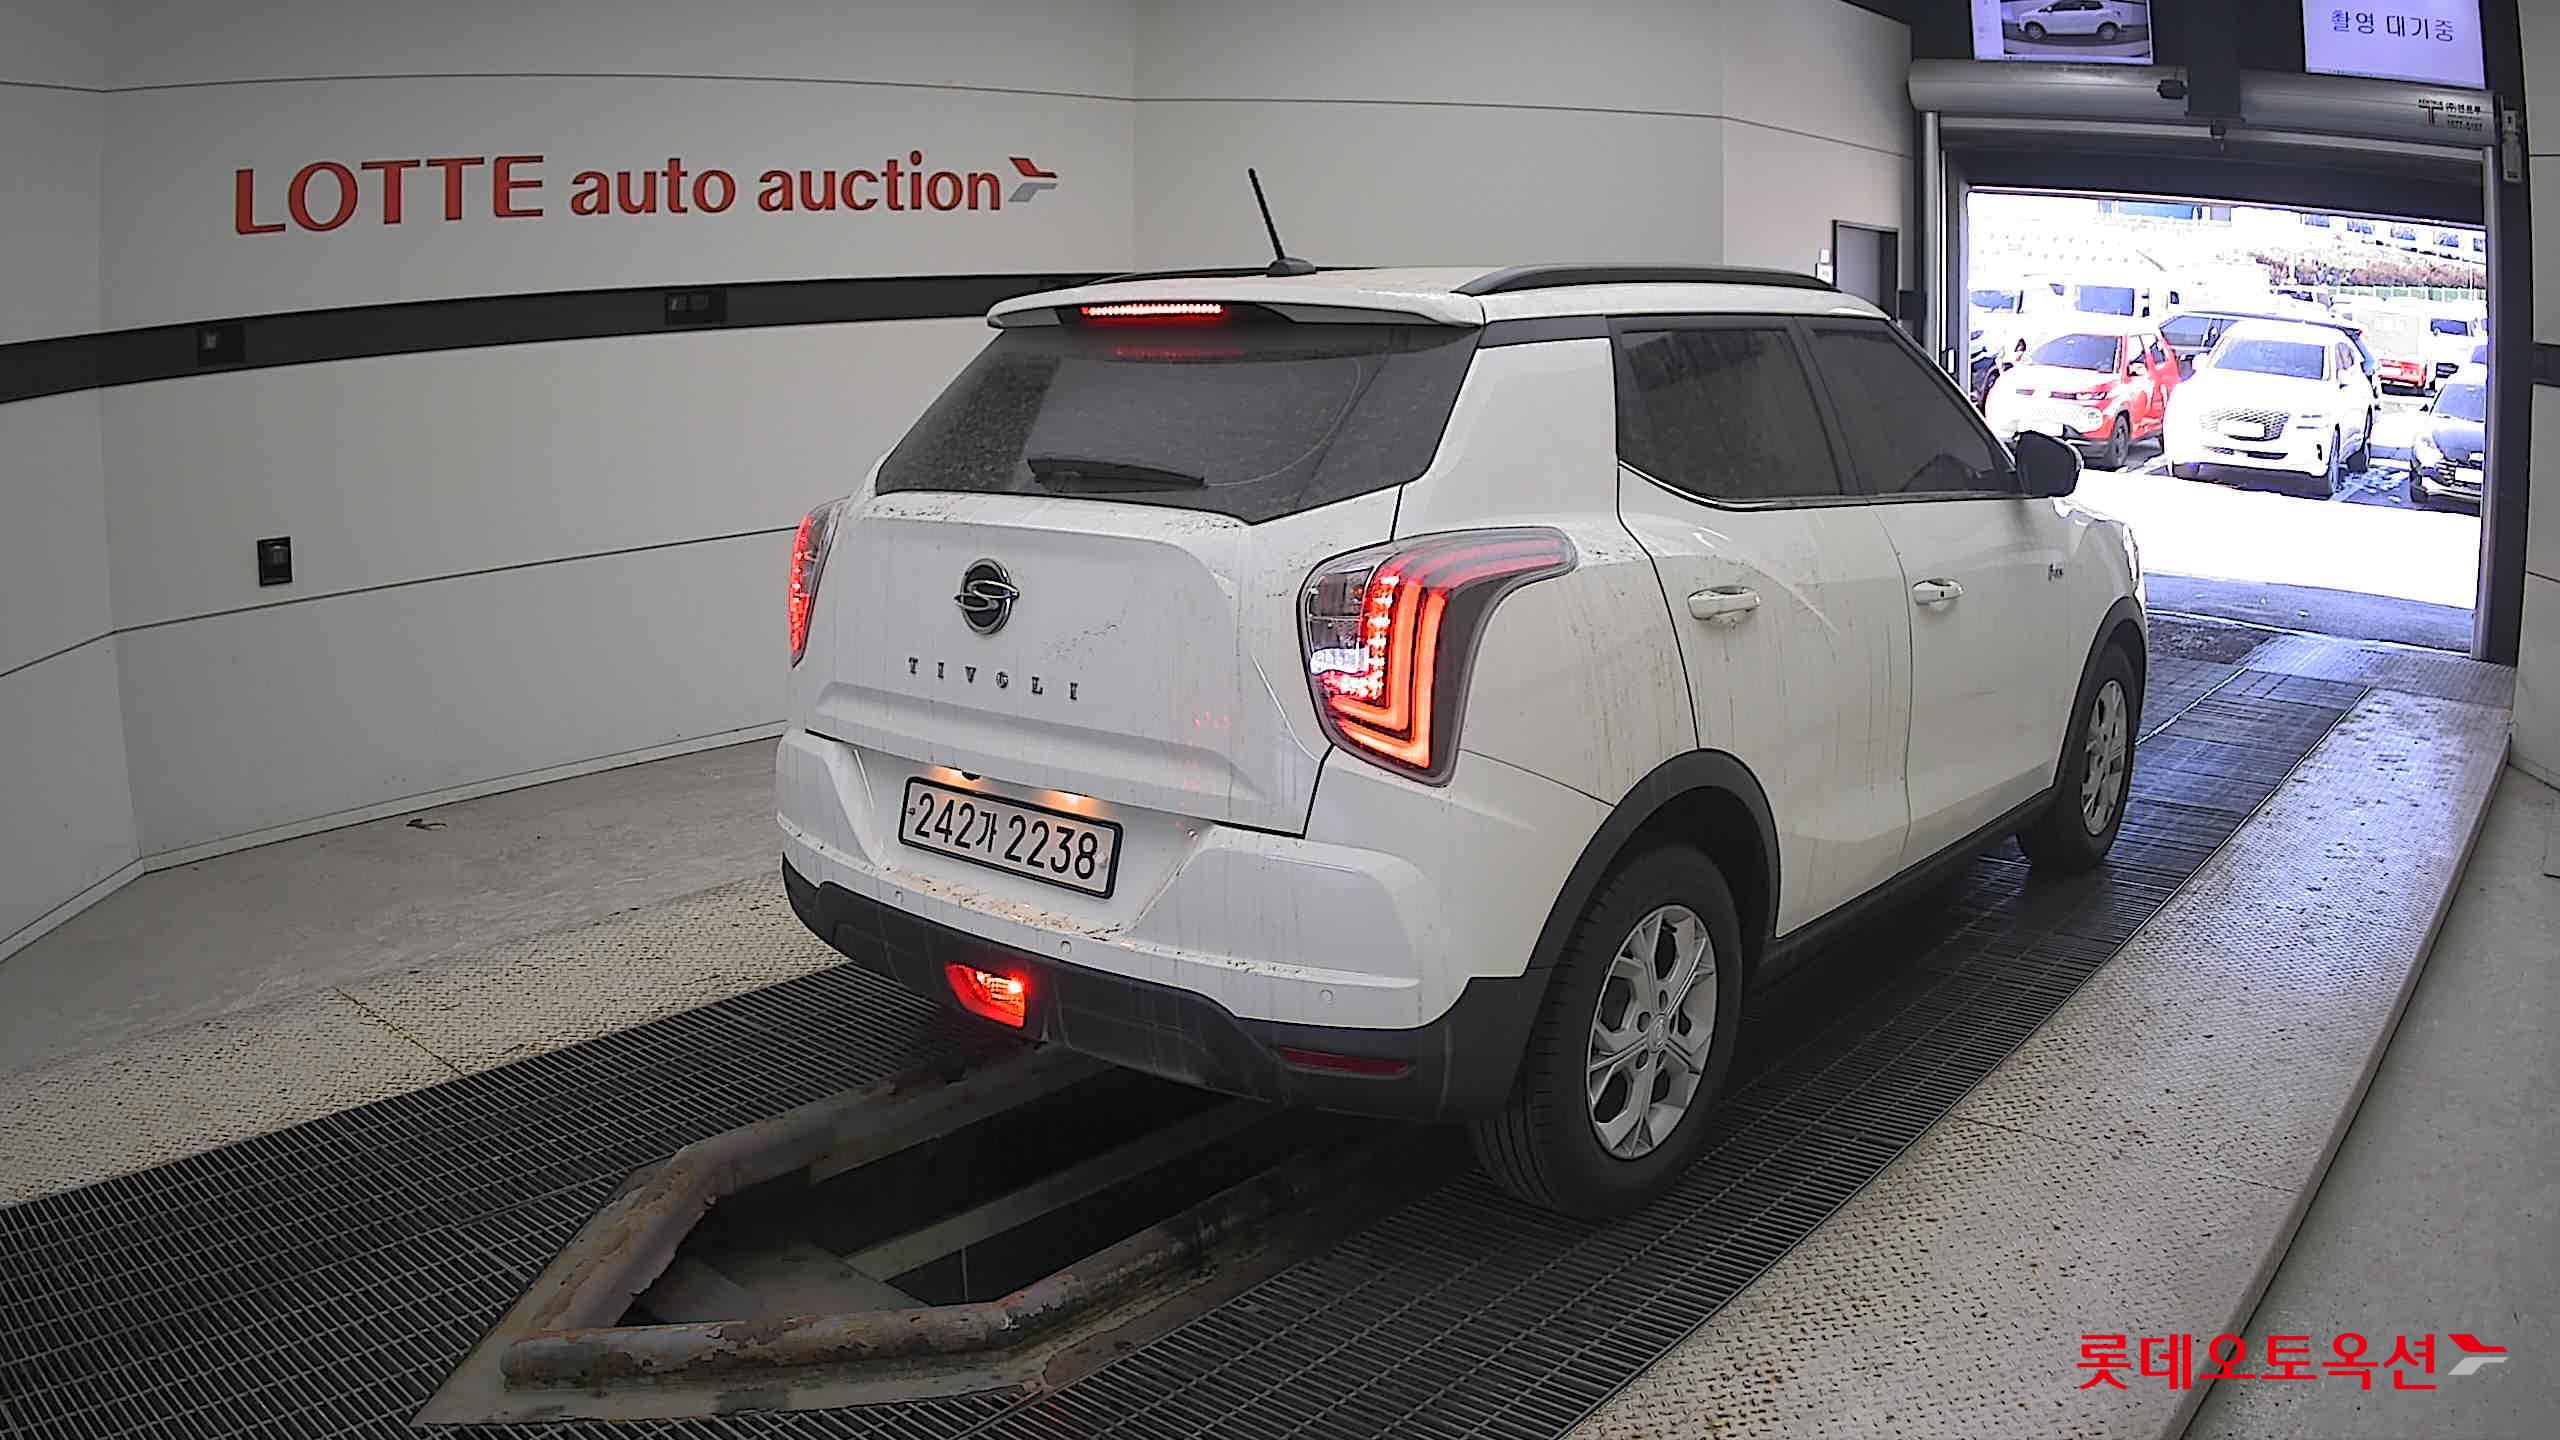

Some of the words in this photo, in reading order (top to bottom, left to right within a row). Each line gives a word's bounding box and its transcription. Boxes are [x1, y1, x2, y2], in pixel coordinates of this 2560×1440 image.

[2331, 9, 2375, 34] 촬영
[2386, 15, 2454, 43] 대기중
[236, 156, 543, 234] LOTTE
[572, 160, 737, 215] auto
[758, 152, 1001, 212] auction
[907, 656, 1079, 701] TIVOLI
[914, 792, 998, 854] 242가
[1003, 813, 1099, 880] 2238
